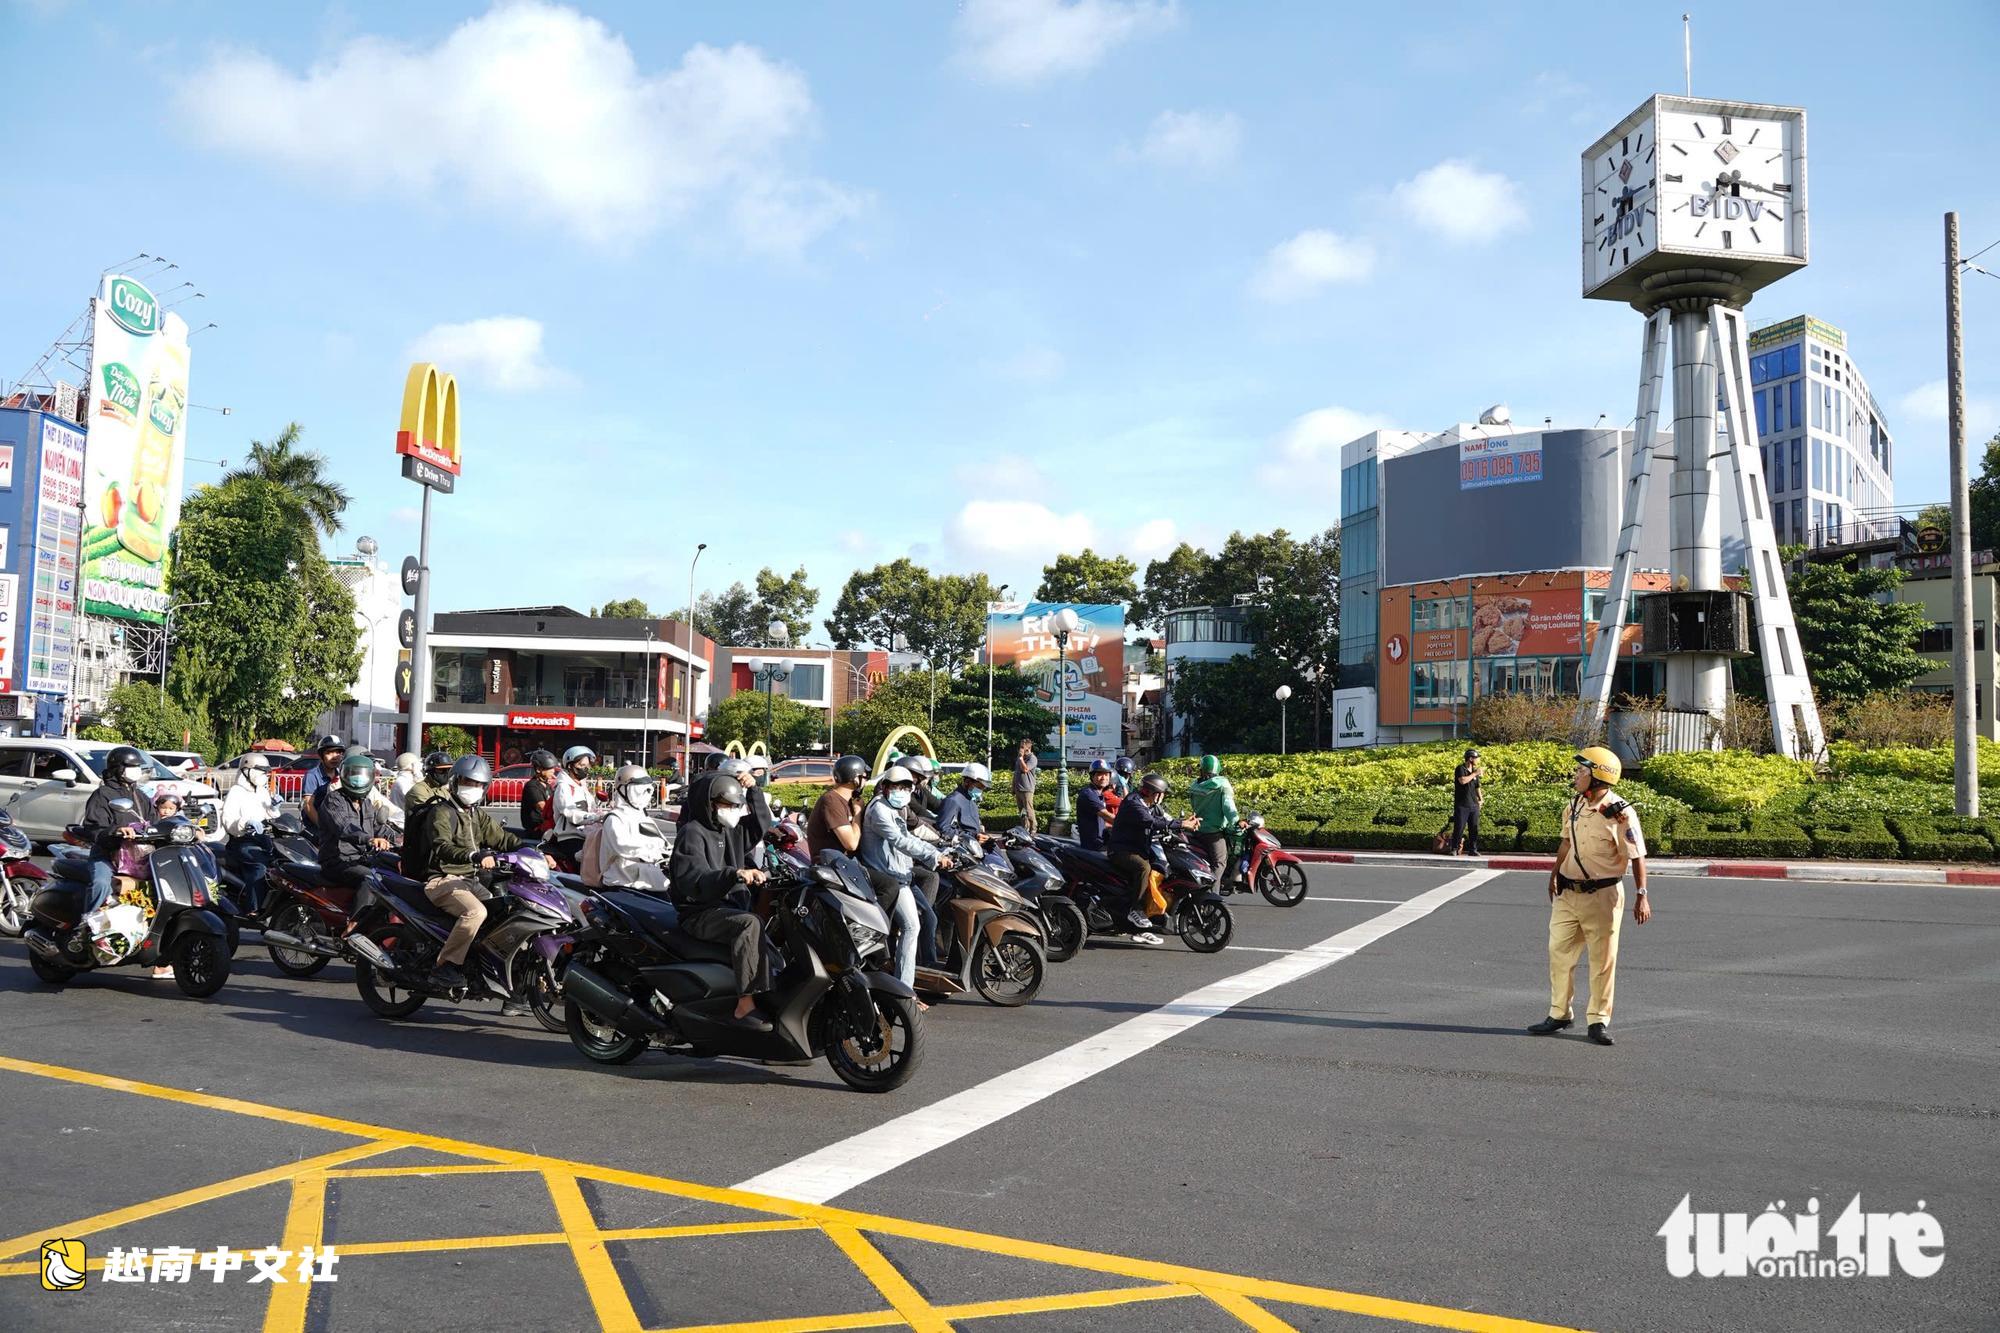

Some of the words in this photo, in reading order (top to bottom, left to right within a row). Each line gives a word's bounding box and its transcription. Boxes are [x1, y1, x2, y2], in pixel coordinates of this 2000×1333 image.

[1690, 194, 1763, 222] BIDV
[1607, 205, 1646, 247] BIDV
[114, 283, 152, 327] Cozy
[151, 402, 174, 432] Cozy
[424, 467, 439, 482] Drive
[58, 579, 70, 591] LS
[1531, 622, 1548, 631] vùng
[1548, 621, 1580, 629] Louisiana
[492, 659, 502, 694] playplace
[512, 715, 570, 726] McDonald's
[1598, 764, 1619, 775] CSGT
